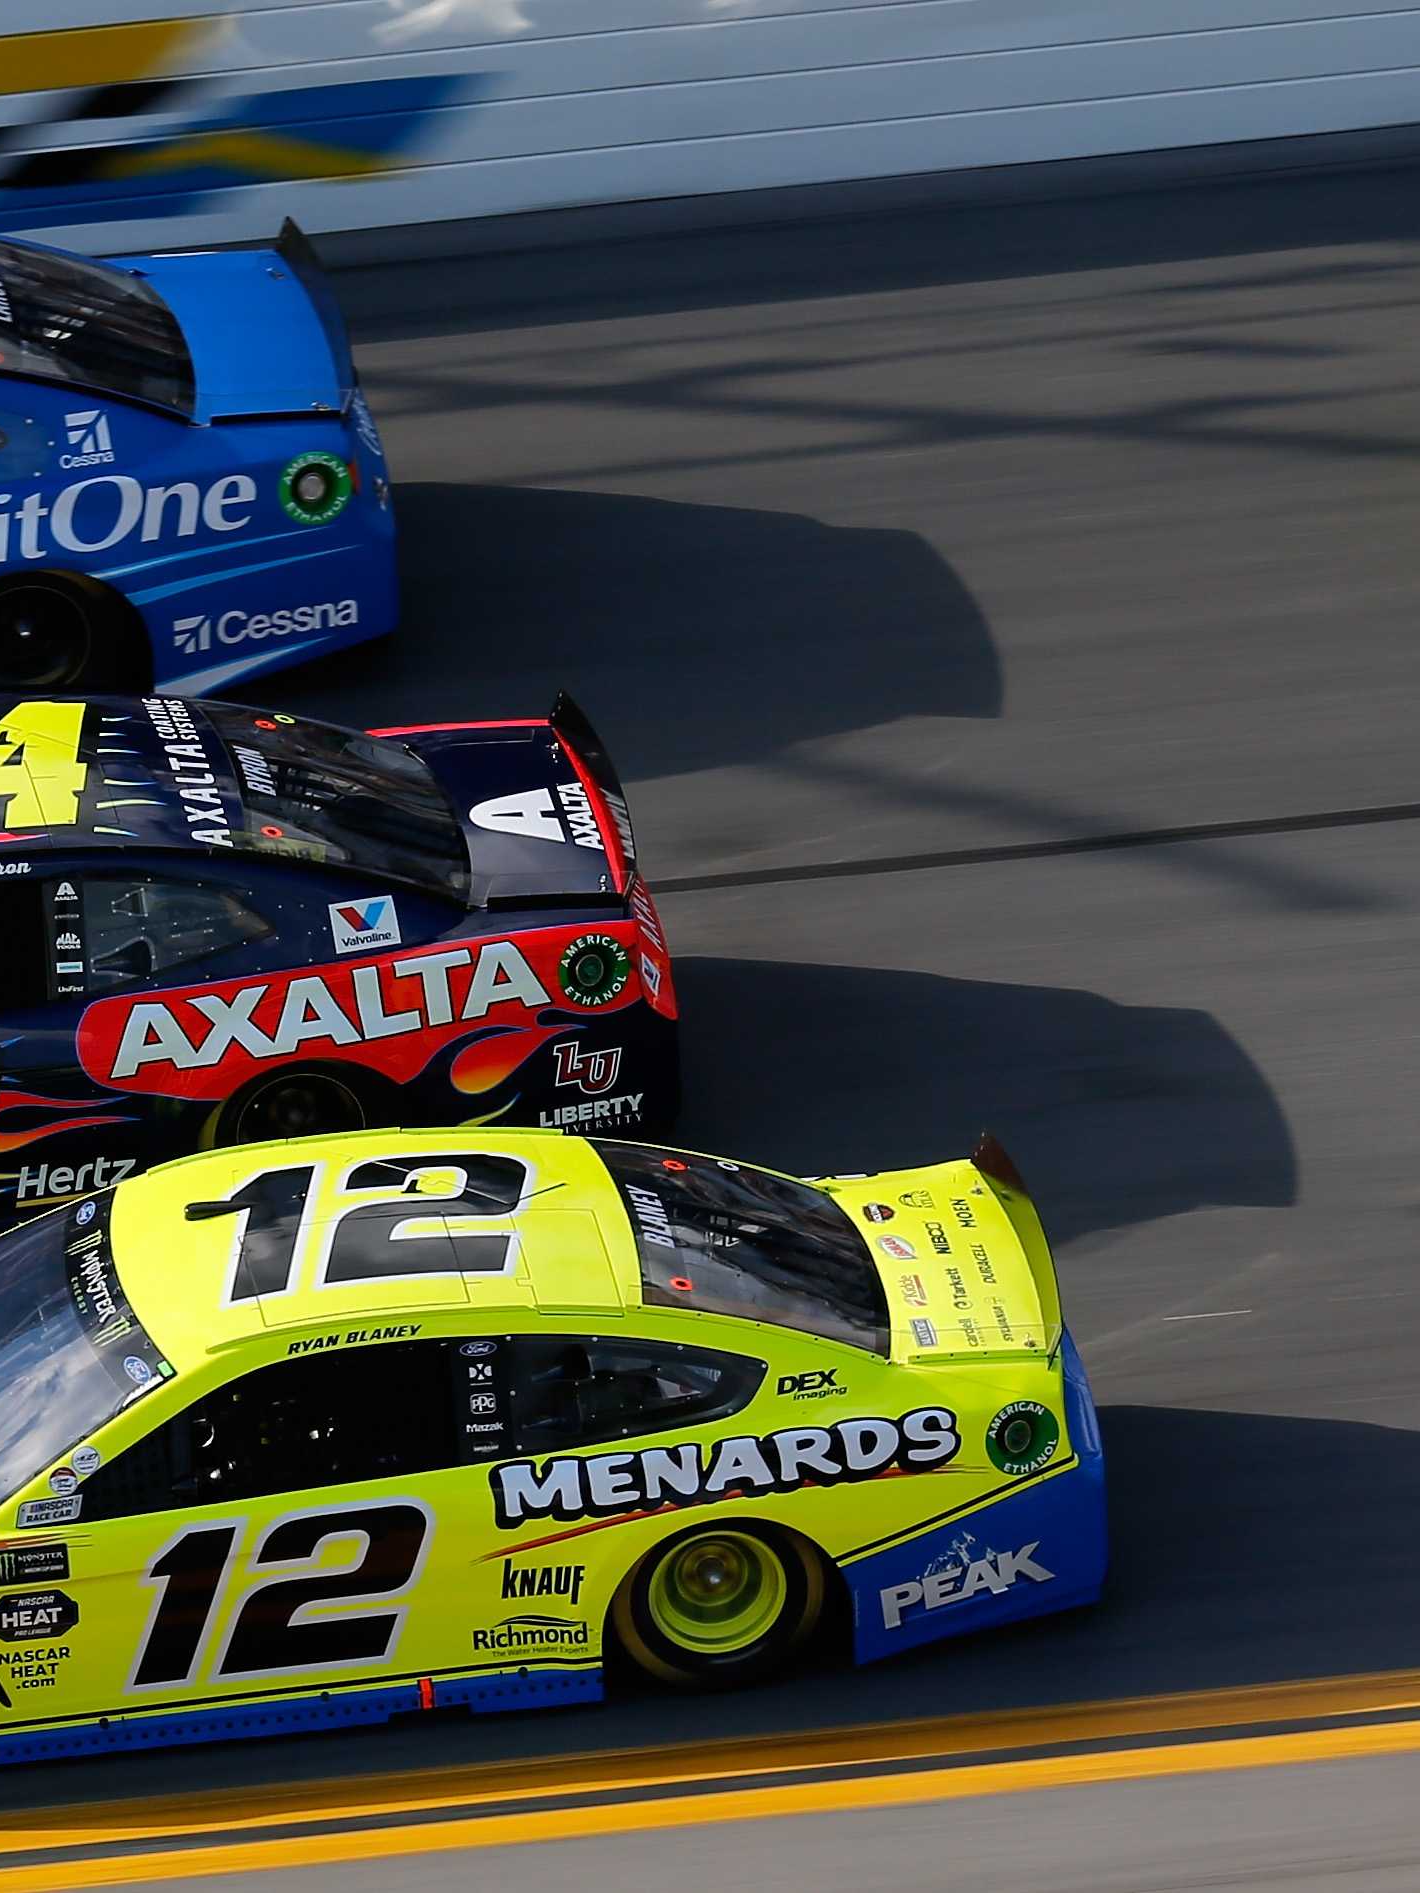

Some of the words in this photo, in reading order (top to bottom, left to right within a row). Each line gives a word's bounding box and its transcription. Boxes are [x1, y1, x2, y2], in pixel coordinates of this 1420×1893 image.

[59, 448, 115, 470] Cessna
[282, 455, 347, 485] AMERICAN
[285, 496, 348, 522] ETHANOL
[217, 599, 358, 646] Cessna
[141, 698, 178, 740] COATING
[164, 699, 200, 741] SYSTEMS
[232, 745, 277, 797] BYRON
[164, 744, 234, 848] AXALTA
[556, 782, 605, 850] AXALTA
[341, 932, 393, 946] Valvoline
[560, 934, 627, 968] AMERICAN
[564, 974, 627, 1007] ETHANOL
[111, 941, 552, 1079] AXALTA
[540, 1093, 644, 1127] LIBERTY
[565, 1113, 643, 1134] IVERSITY
[17, 1157, 136, 1199] Hertz
[222, 1152, 533, 1305] 12
[625, 1184, 675, 1249] BLANEY
[949, 1198, 977, 1228] MOEN
[970, 1244, 997, 1284] DURACELL
[80, 1250, 117, 1323] MONSTER
[945, 1267, 968, 1299] Tarkett
[288, 1335, 340, 1355] RYAN
[345, 1324, 422, 1344] BLANEY
[464, 1343, 492, 1355] Ford
[777, 1368, 838, 1395] DEX
[471, 1396, 495, 1411] PPG
[988, 1402, 1045, 1438] AMERICAN
[466, 1422, 504, 1433] Mazak
[495, 1409, 960, 1522] MENARDS
[1003, 1439, 1057, 1473] ETHANOL
[26, 1513, 50, 1523] RACE
[53, 1509, 72, 1519] CAR
[17, 1595, 55, 1607] NASCAR
[128, 1500, 432, 1690] 12
[880, 1540, 1056, 1629] PEAK
[1, 1607, 63, 1629] HEAT
[473, 1621, 588, 1650] Richmond
[492, 1650, 506, 1658] The
[507, 1648, 531, 1657] Water
[532, 1646, 559, 1654] Heater
[559, 1646, 589, 1654] Experts
[11, 1662, 60, 1679] HEAT
[16, 1677, 55, 1689] .com
